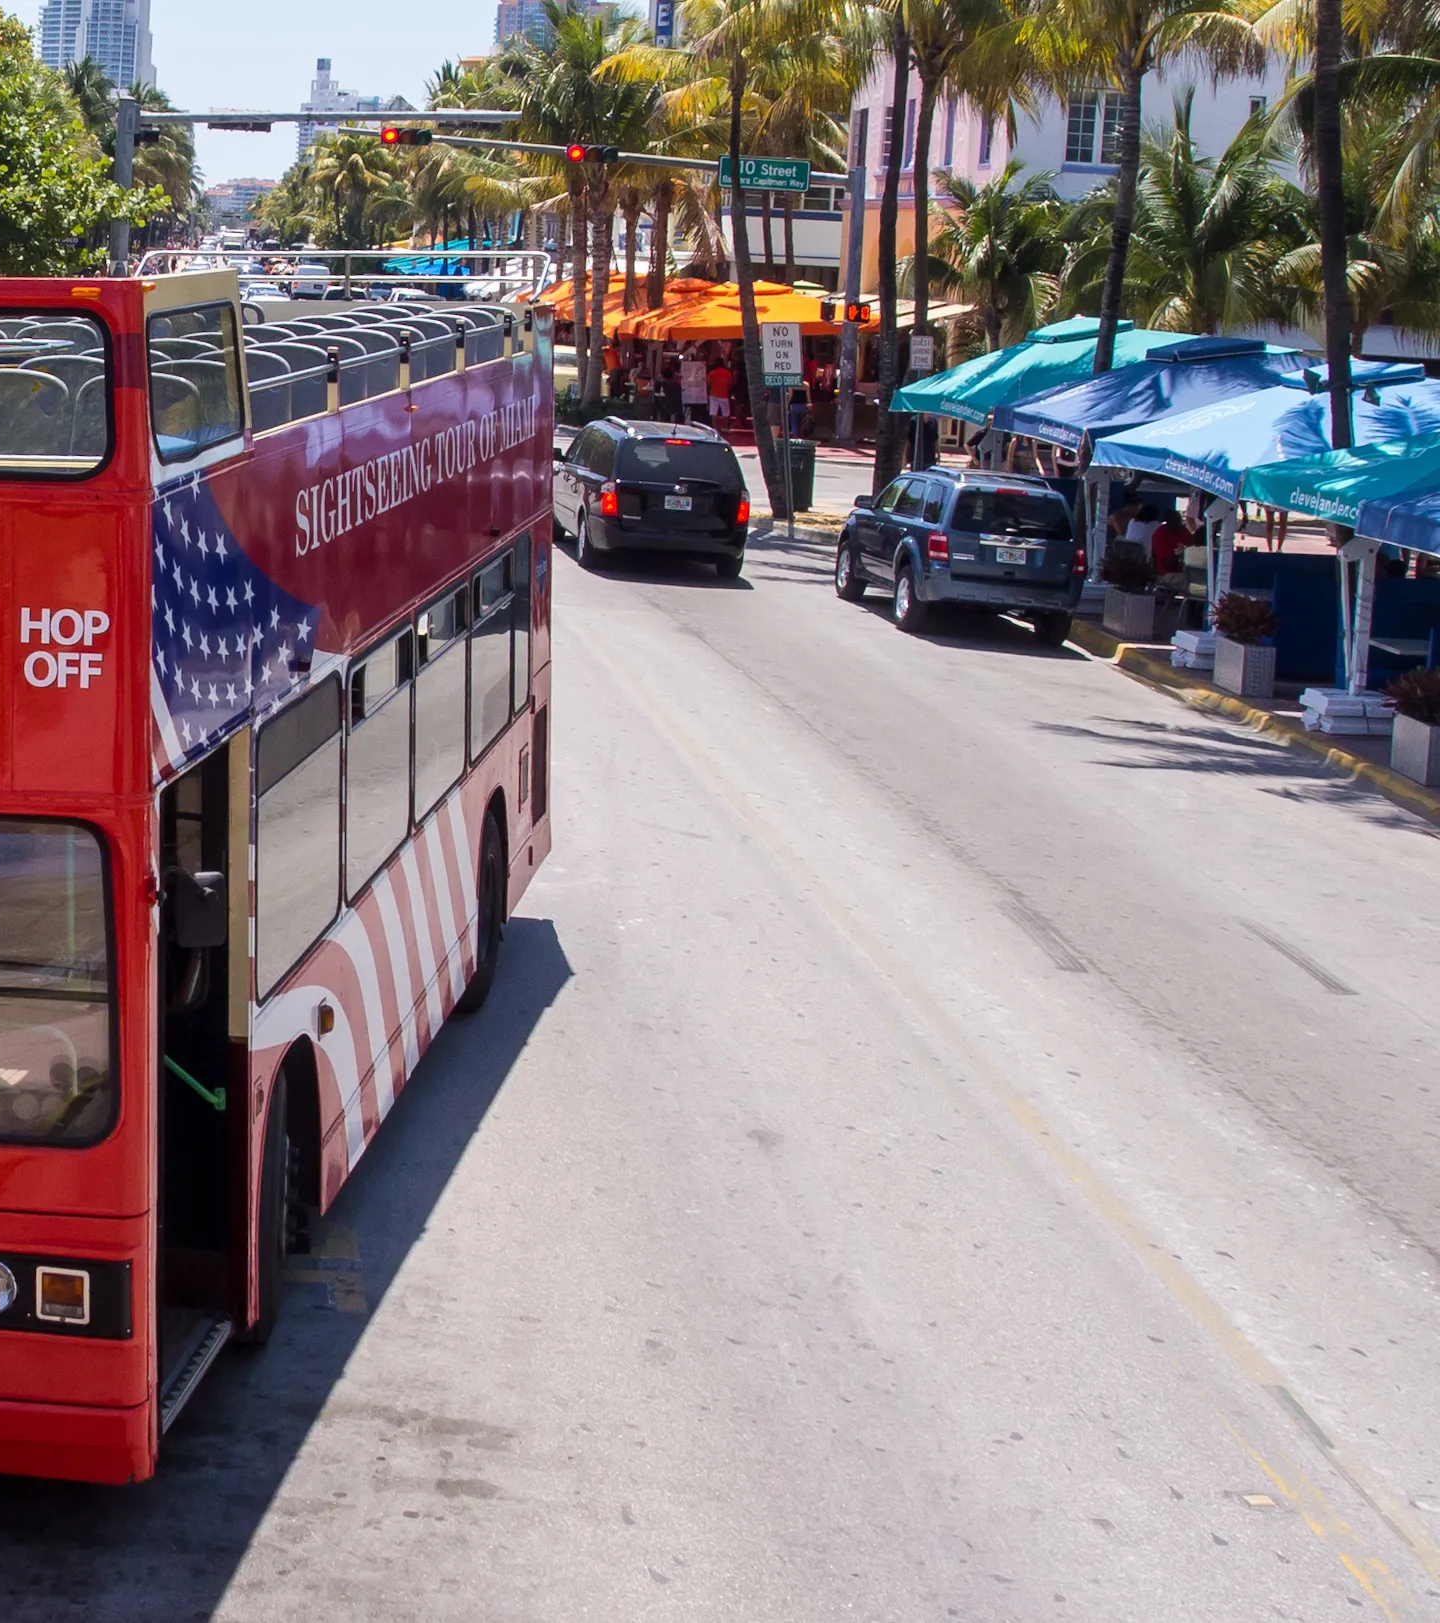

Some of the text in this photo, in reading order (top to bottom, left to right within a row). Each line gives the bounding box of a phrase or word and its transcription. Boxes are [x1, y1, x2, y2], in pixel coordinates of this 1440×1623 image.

[761, 163, 797, 177] Street
[722, 175, 751, 185] Baara
[789, 179, 805, 188] Way
[772, 326, 789, 337] NO
[770, 340, 793, 348] TURN
[775, 351, 789, 359] ON
[774, 362, 792, 370] RED
[765, 375, 802, 386] DECO DRIVE
[295, 396, 537, 558] SIGHTSEEING TOUR OF MIAMI
[1165, 454, 1234, 495] clevelander.com
[20, 607, 110, 646] HOP
[23, 650, 103, 689] OFF
